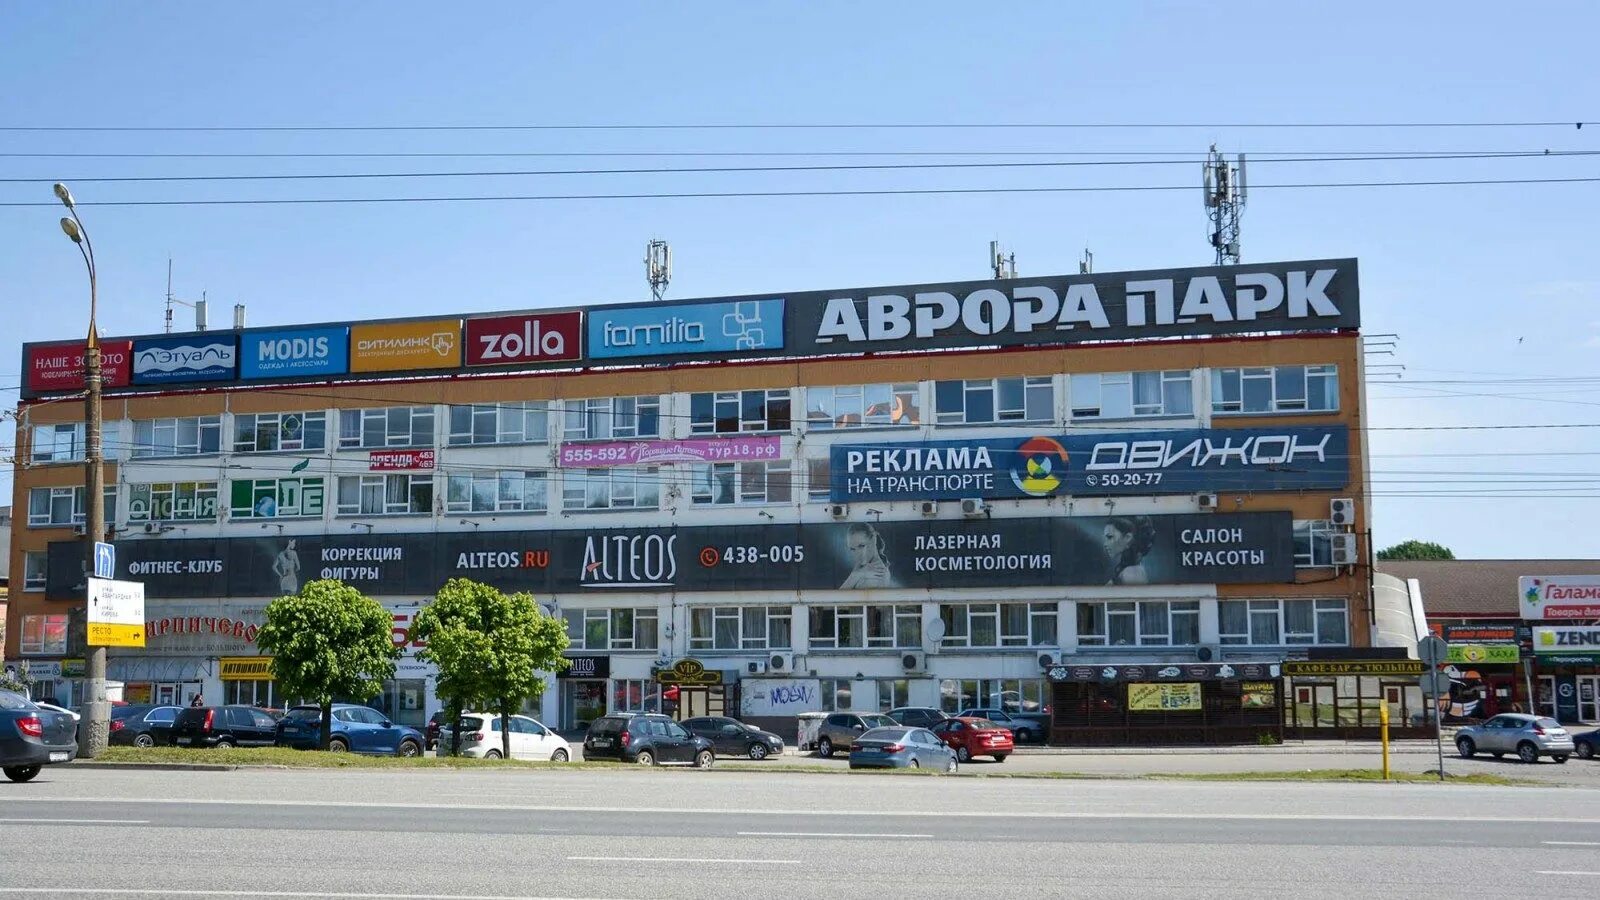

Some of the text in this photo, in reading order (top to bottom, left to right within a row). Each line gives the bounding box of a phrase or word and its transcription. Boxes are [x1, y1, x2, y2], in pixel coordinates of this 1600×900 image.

[815, 269, 1341, 343] АВРОРА ПАРК
[480, 320, 564, 359] zolla
[604, 317, 704, 347] familia
[259, 337, 329, 361] MODIS
[357, 337, 430, 350] СИТИЛИНК
[36, 357, 69, 369] НАШЕ
[565, 448, 627, 462] 555-592
[708, 444, 776, 458] тур18.рф
[1085, 434, 1331, 471] ДВИЖОН
[848, 446, 993, 474] РЕКЛАМА
[848, 473, 994, 493] НА ТРАНСПОРТЕ
[1102, 473, 1162, 486] 50-20-77
[914, 533, 1002, 550] ЛАЗЕРНАЯ
[1181, 528, 1243, 544] САЛОН
[321, 547, 402, 563] КОРРЕКЦИЯ
[457, 550, 550, 570] ALTEOS.RU
[580, 534, 677, 581] ALTEOS
[724, 545, 805, 564] 438-005
[915, 554, 1052, 572] КОСМЕТОЛОГИЯ
[1182, 549, 1265, 567] КРАСОТЫ
[129, 559, 223, 576] ФИТНЕС-КЛУБ
[321, 566, 379, 581] ФИГУРЫ
[680, 662, 698, 672] VIP
[1296, 662, 1422, 673] КАФЕ-БАР ТЮЛЬПАН
